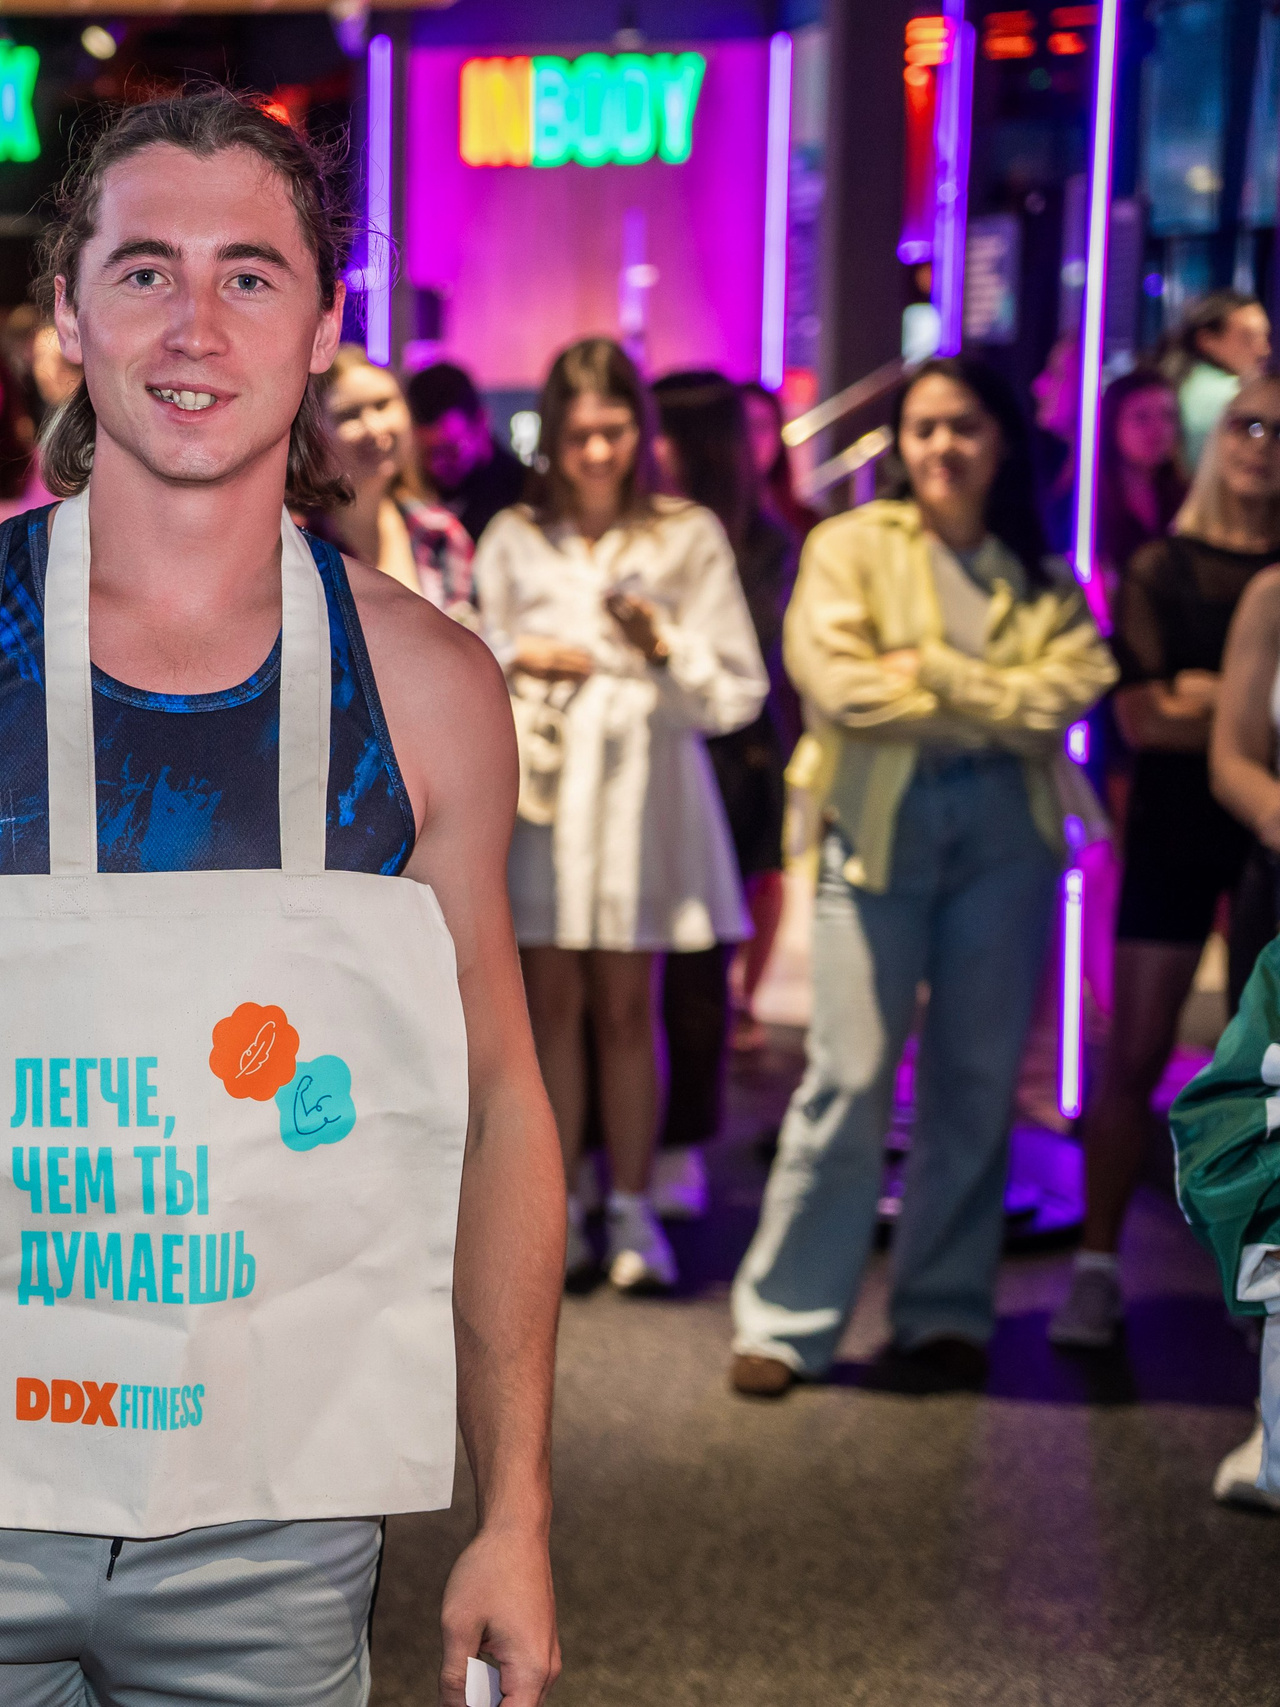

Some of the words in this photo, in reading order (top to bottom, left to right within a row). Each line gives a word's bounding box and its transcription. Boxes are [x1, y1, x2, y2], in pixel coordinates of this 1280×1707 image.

[458, 52, 706, 168] INBODY
[10, 1056, 176, 1139] ЛЕГЧЕ,
[12, 1146, 116, 1214] ЧЕМ
[133, 1145, 209, 1215] ТЫ
[17, 1230, 256, 1306] ДУМАЕШЬ
